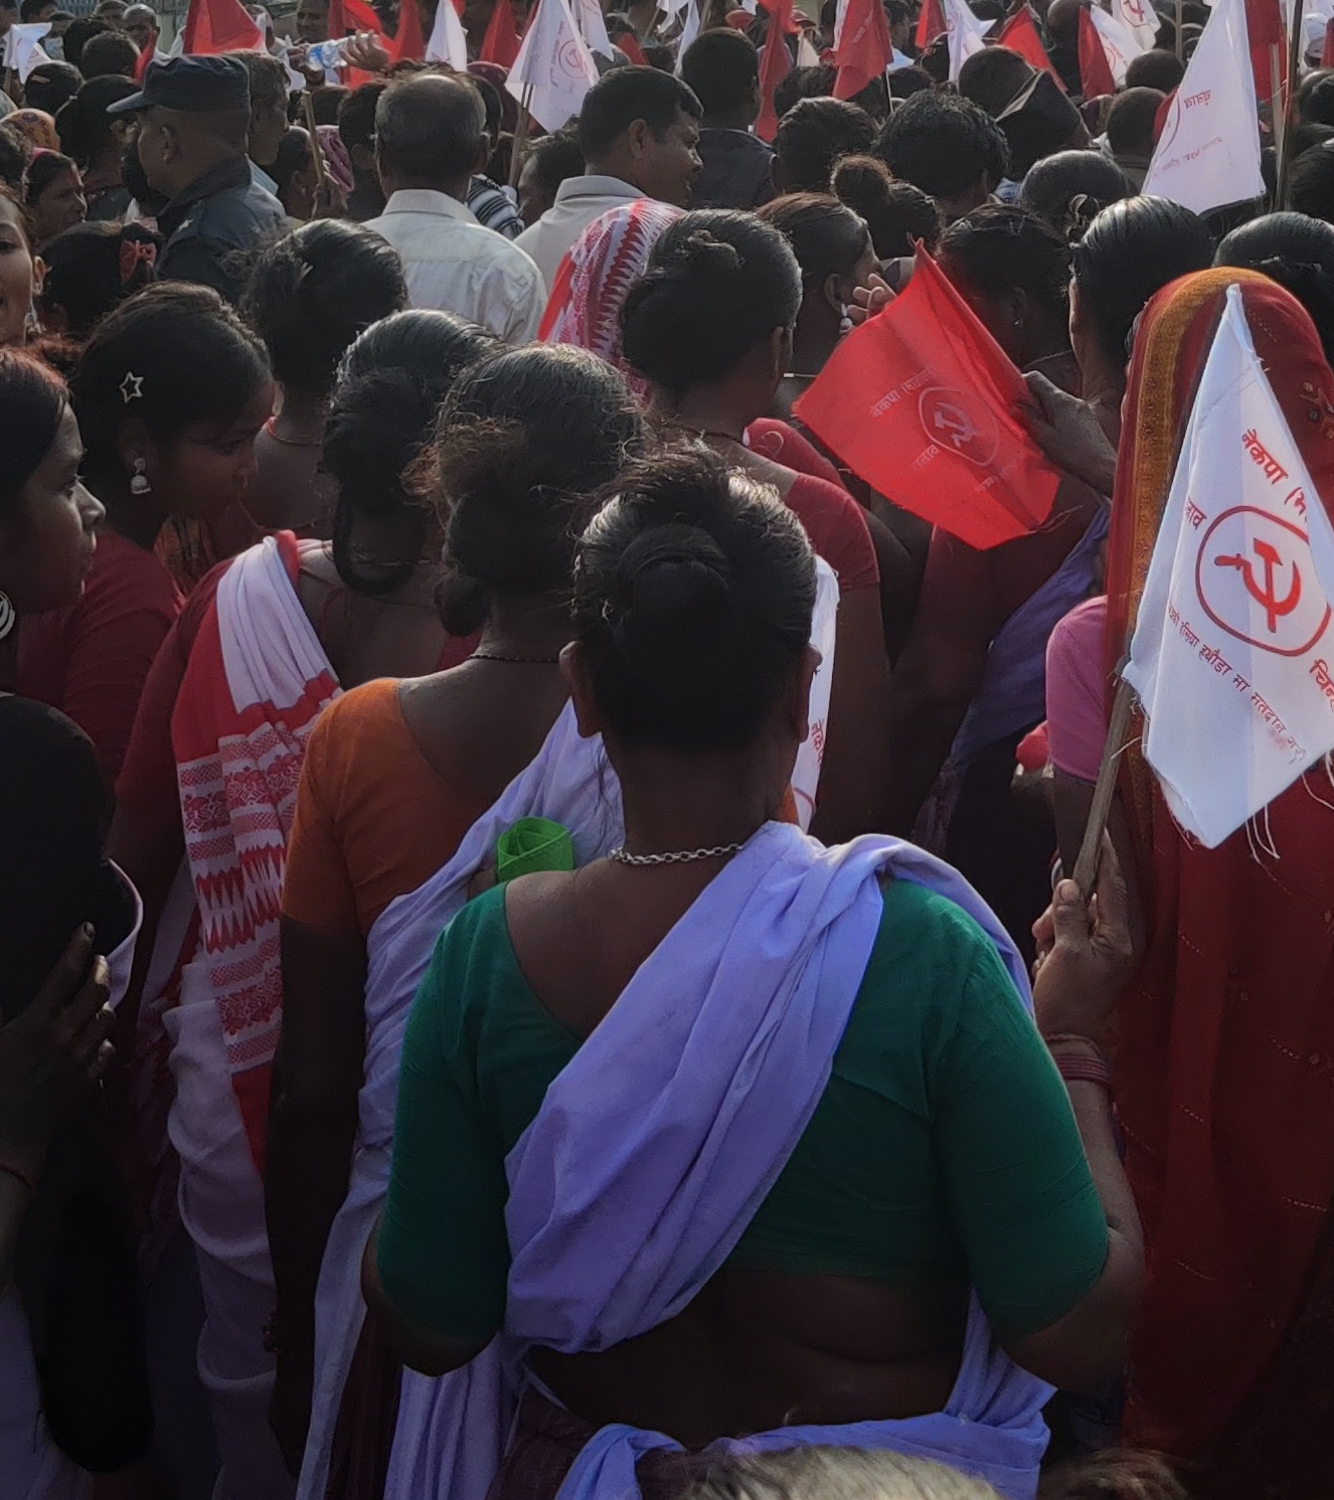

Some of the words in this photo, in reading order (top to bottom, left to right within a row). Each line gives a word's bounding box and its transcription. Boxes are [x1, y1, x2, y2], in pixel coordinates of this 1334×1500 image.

[1241, 427, 1289, 488] नेकपा
[1232, 674, 1251, 693] मा
[1250, 691, 1288, 734] मतदान
